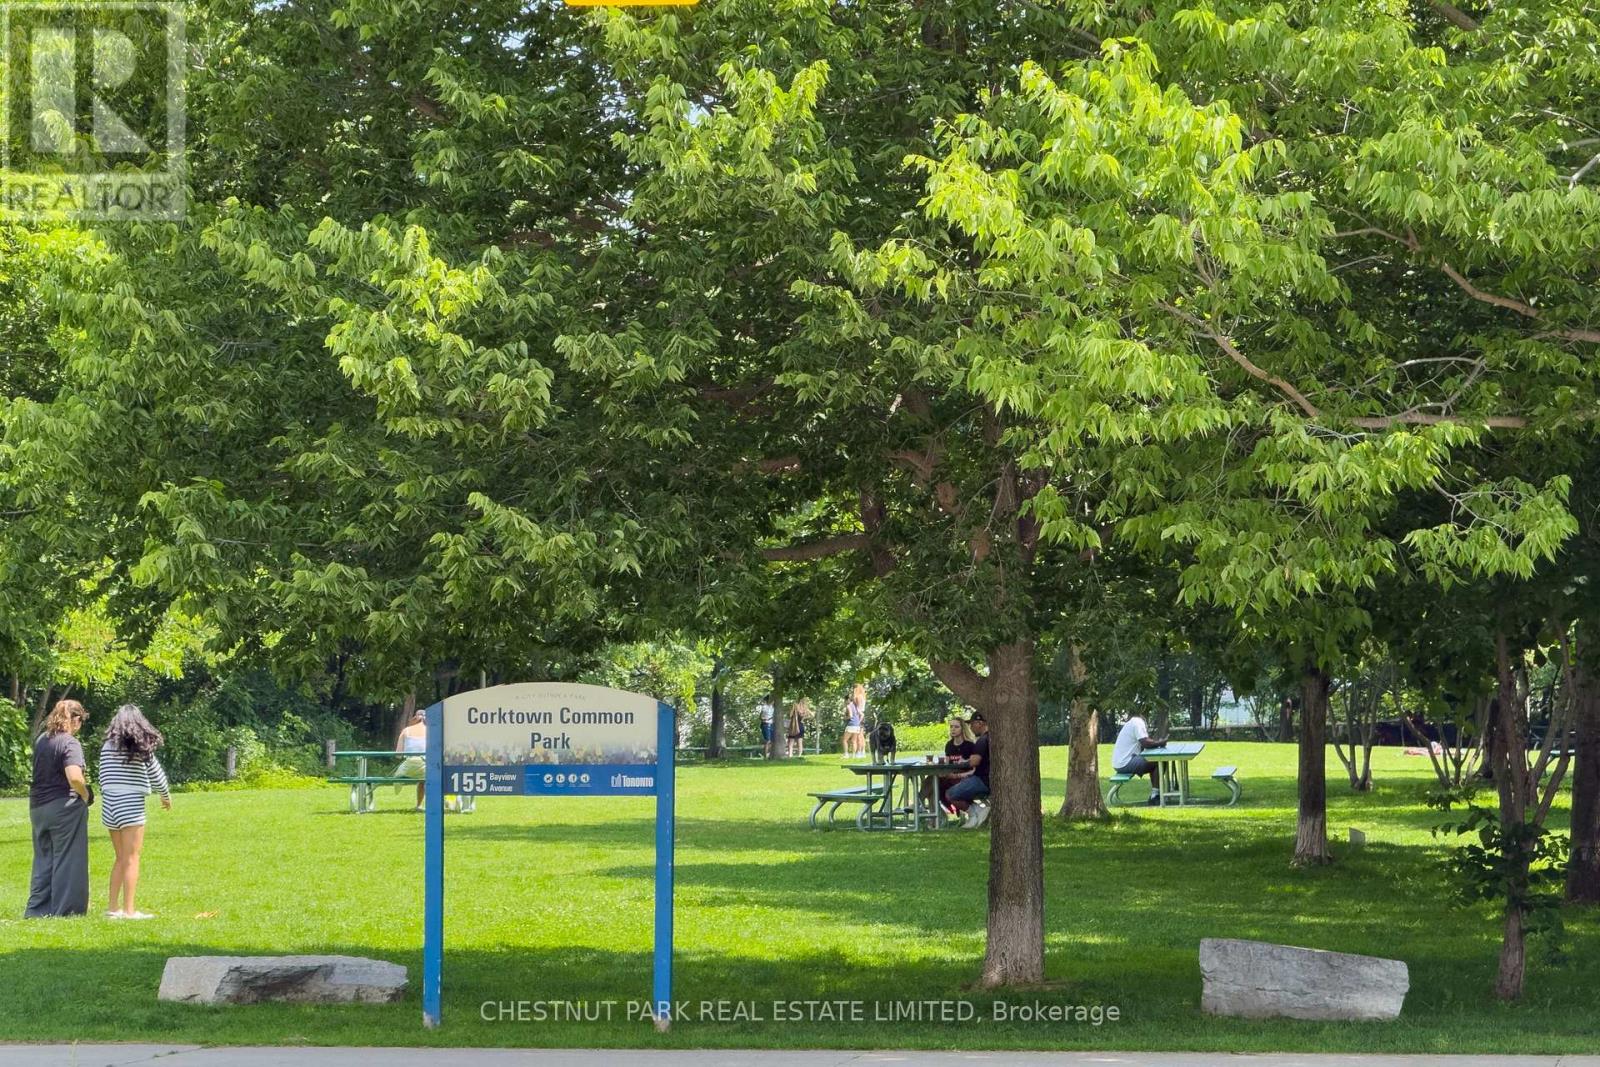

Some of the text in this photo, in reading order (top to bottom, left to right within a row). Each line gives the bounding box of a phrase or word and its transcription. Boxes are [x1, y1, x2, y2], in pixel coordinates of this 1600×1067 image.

[467, 707, 634, 724] Corktown Common
[530, 732, 571, 749] Park
[451, 772, 487, 792] 155
[489, 773, 517, 782] Bayview
[489, 784, 513, 792] Avenue
